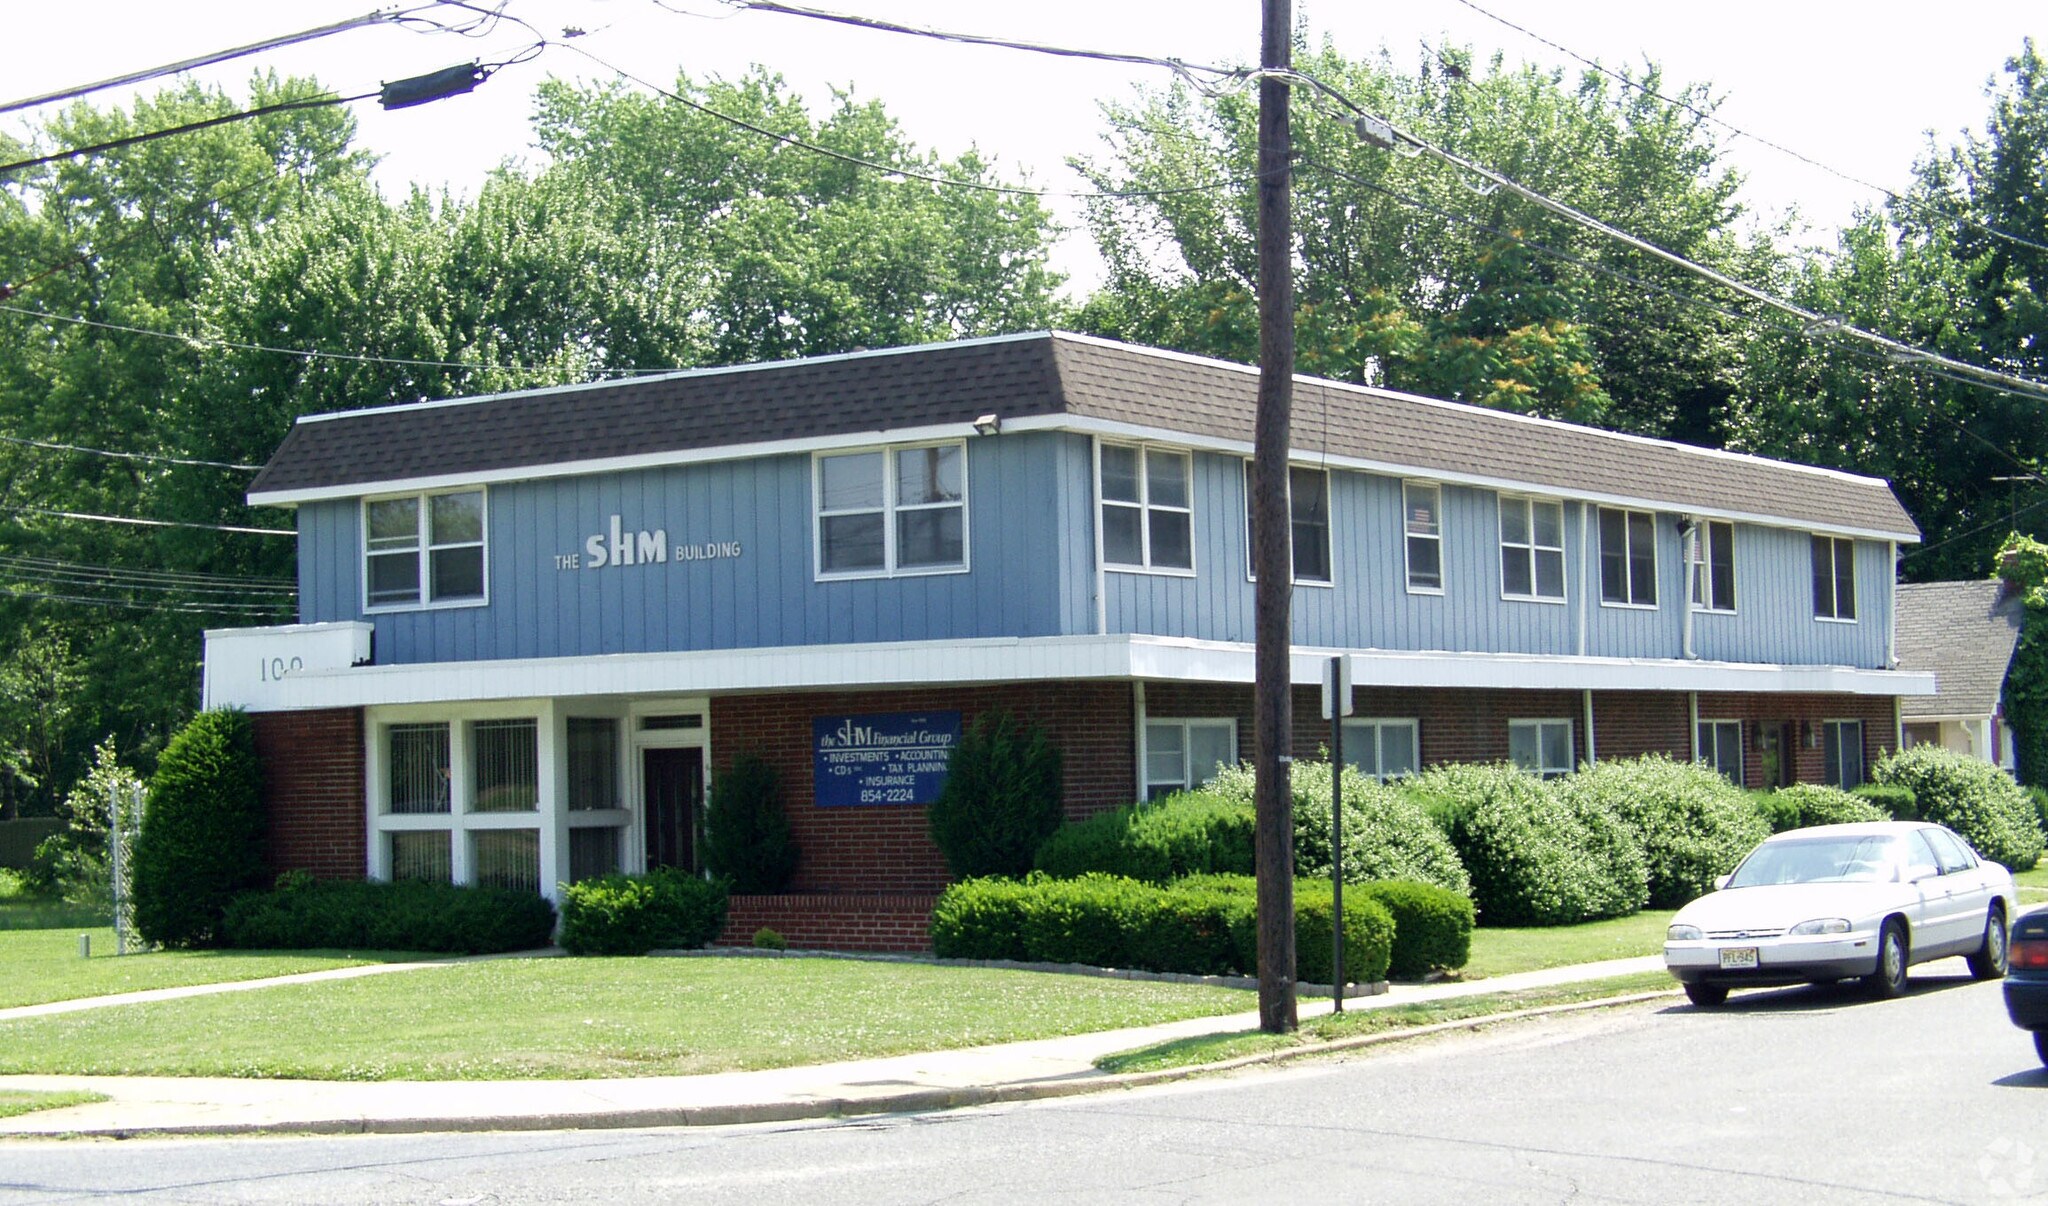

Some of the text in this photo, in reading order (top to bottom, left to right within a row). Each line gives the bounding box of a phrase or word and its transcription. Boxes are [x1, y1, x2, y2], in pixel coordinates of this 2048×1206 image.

[554, 554, 580, 570] THE
[675, 541, 741, 561] BUILDING
[821, 734, 835, 748] the
[873, 731, 917, 747] Financial
[919, 730, 952, 747] Group
[829, 749, 950, 763] INVESTMENTS ACCOUNTIN
[887, 763, 903, 774] TAX
[907, 761, 949, 773] PLANNIN
[865, 774, 915, 787] INSURANCE
